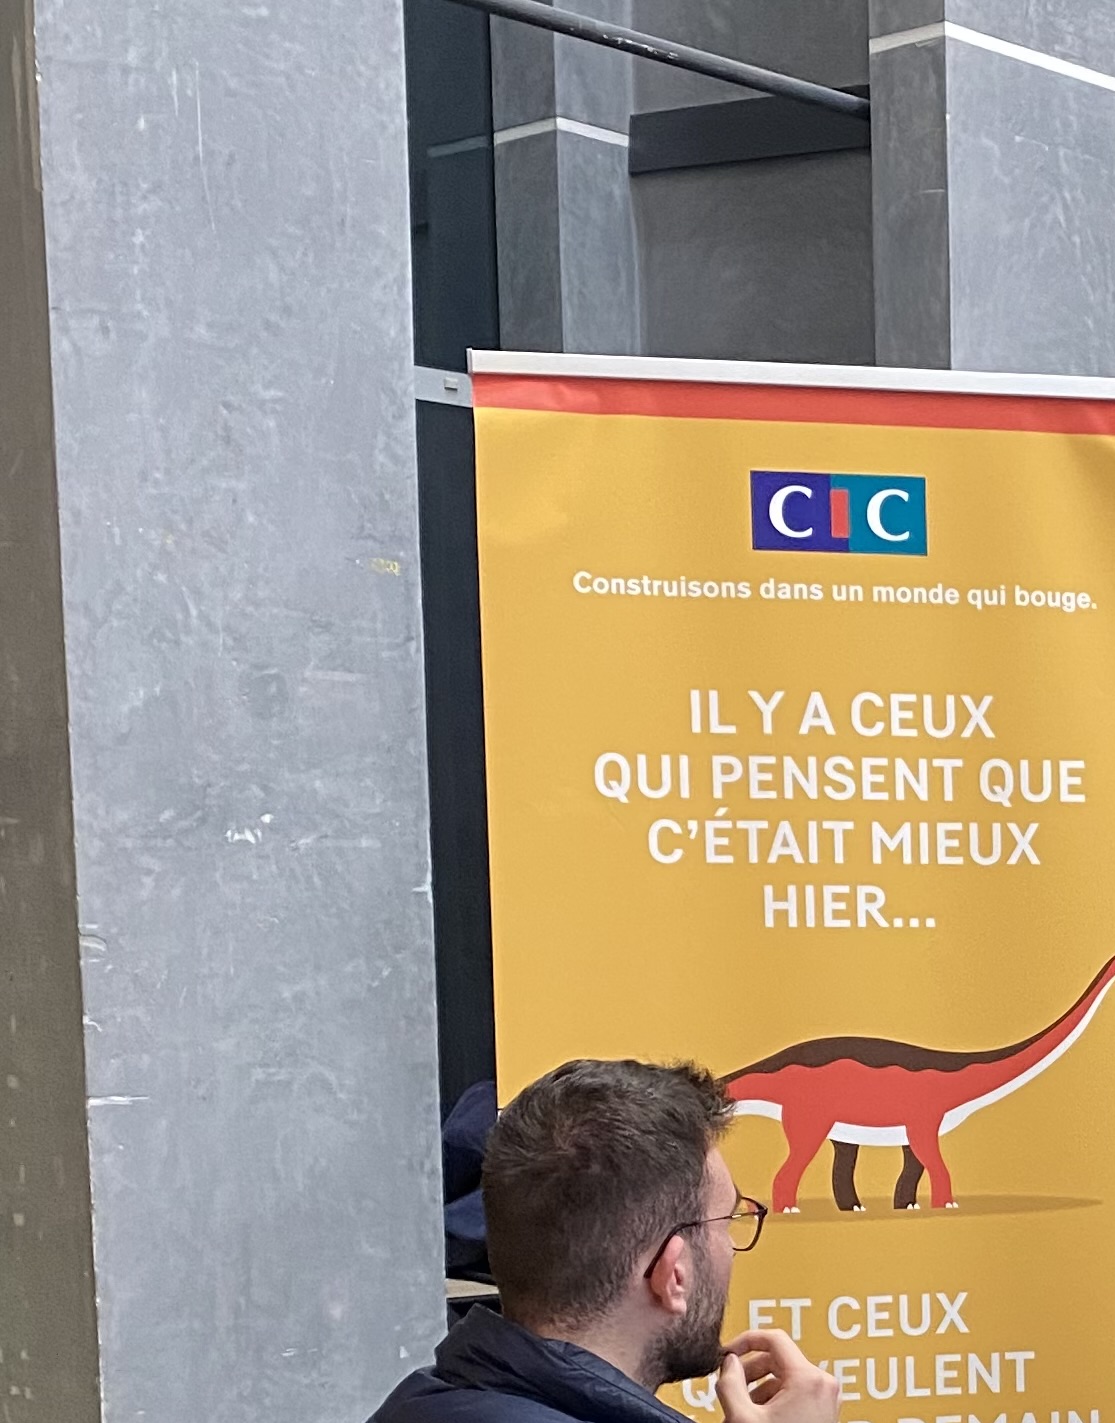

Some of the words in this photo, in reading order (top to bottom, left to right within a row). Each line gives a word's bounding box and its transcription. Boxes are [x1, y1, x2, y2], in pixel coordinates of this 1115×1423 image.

[768, 483, 910, 541] CIC
[573, 570, 751, 599] Construisons
[760, 576, 823, 602] dans
[832, 584, 863, 602] un
[872, 580, 959, 606] monde
[967, 584, 1006, 611] qui
[1014, 585, 1097, 613] bouge.
[690, 689, 736, 735] IL
[748, 690, 785, 735] Y
[798, 691, 835, 736] A
[851, 692, 995, 738] CEUX
[594, 752, 690, 803] QUI
[711, 755, 962, 802] PENSENT
[979, 759, 1086, 807] QUE
[870, 821, 1040, 866] MIEUX
[763, 884, 936, 929] HIER...
[748, 1299, 811, 1341] ET
[828, 1292, 969, 1340] CEUX
[819, 1351, 1036, 1403] EULENT
